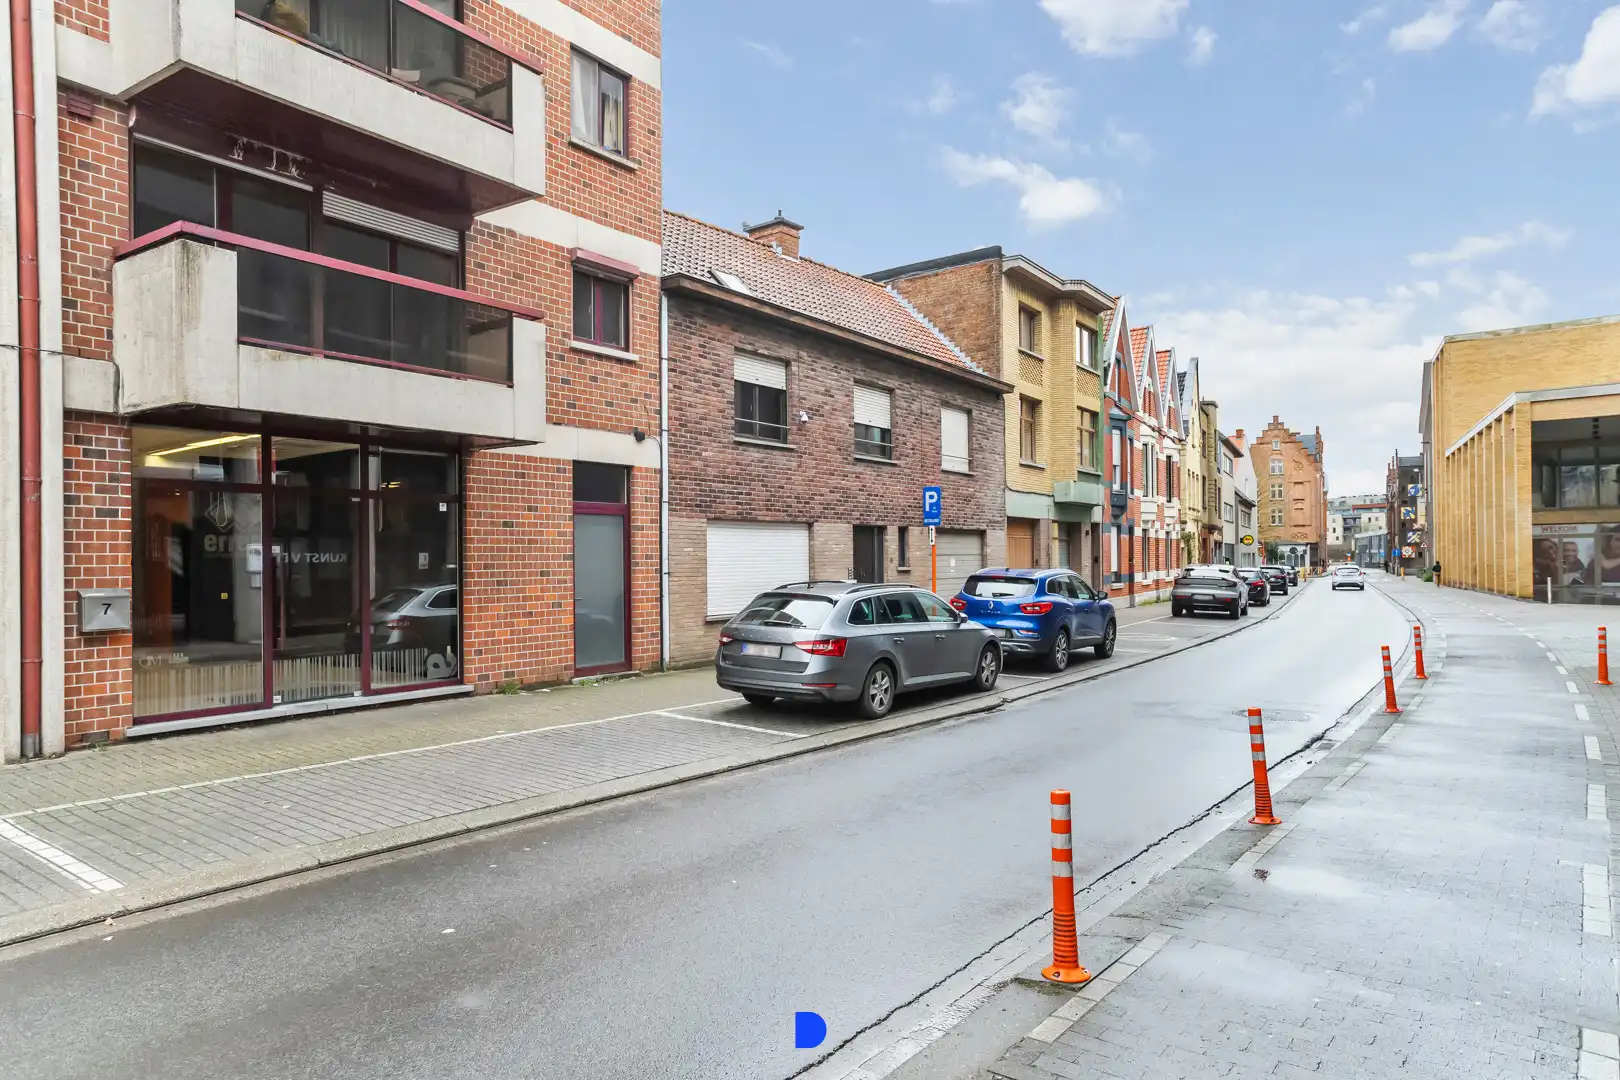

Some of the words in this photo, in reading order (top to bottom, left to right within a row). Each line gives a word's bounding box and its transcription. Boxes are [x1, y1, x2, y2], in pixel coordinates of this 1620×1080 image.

[925, 491, 938, 512] P
[1541, 525, 1578, 533] WELKOM
[101, 603, 112, 615] 7
